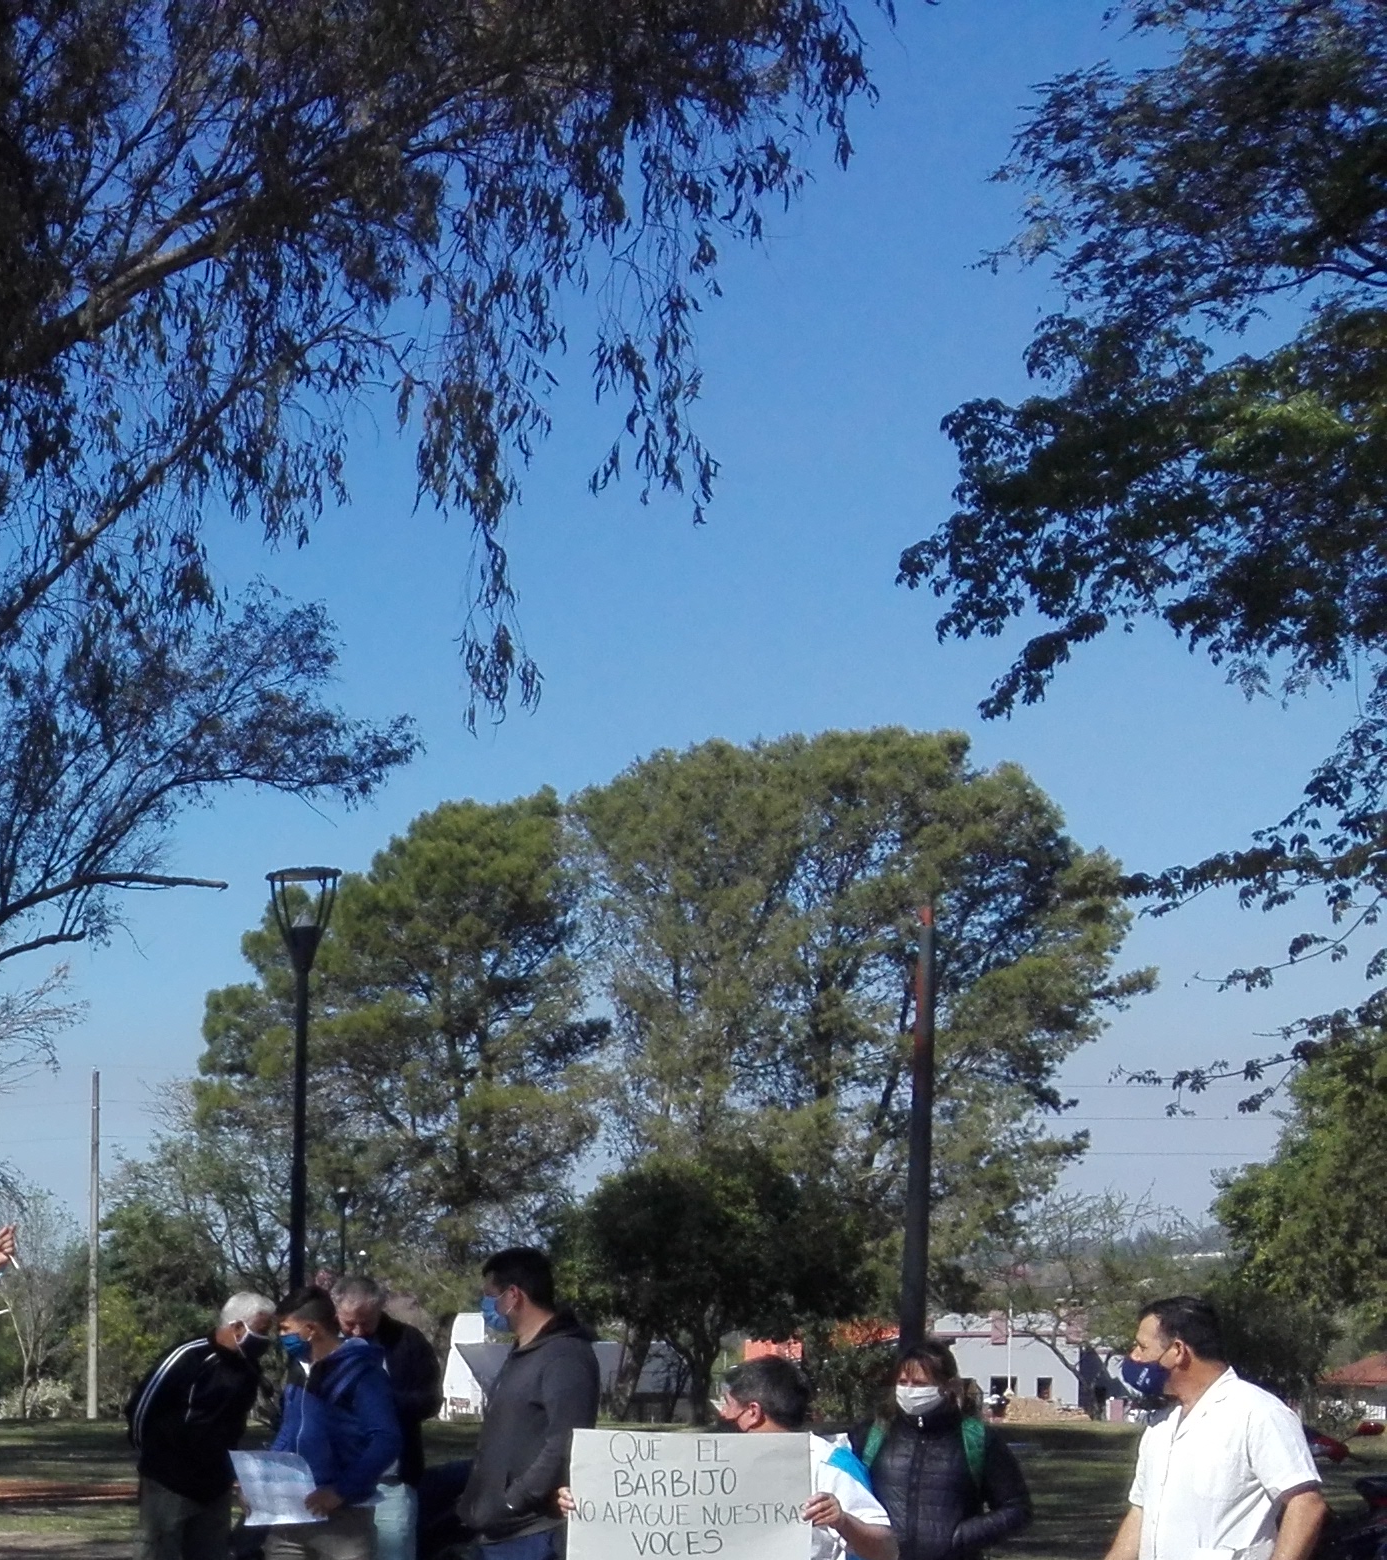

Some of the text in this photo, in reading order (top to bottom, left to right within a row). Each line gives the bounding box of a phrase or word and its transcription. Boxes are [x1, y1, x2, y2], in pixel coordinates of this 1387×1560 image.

[609, 1432, 730, 1470] QUE EL
[614, 1467, 737, 1498] BARBIJO
[571, 1498, 811, 1526] NO APAGUE NUESTRAS
[632, 1529, 723, 1556] VOCES
